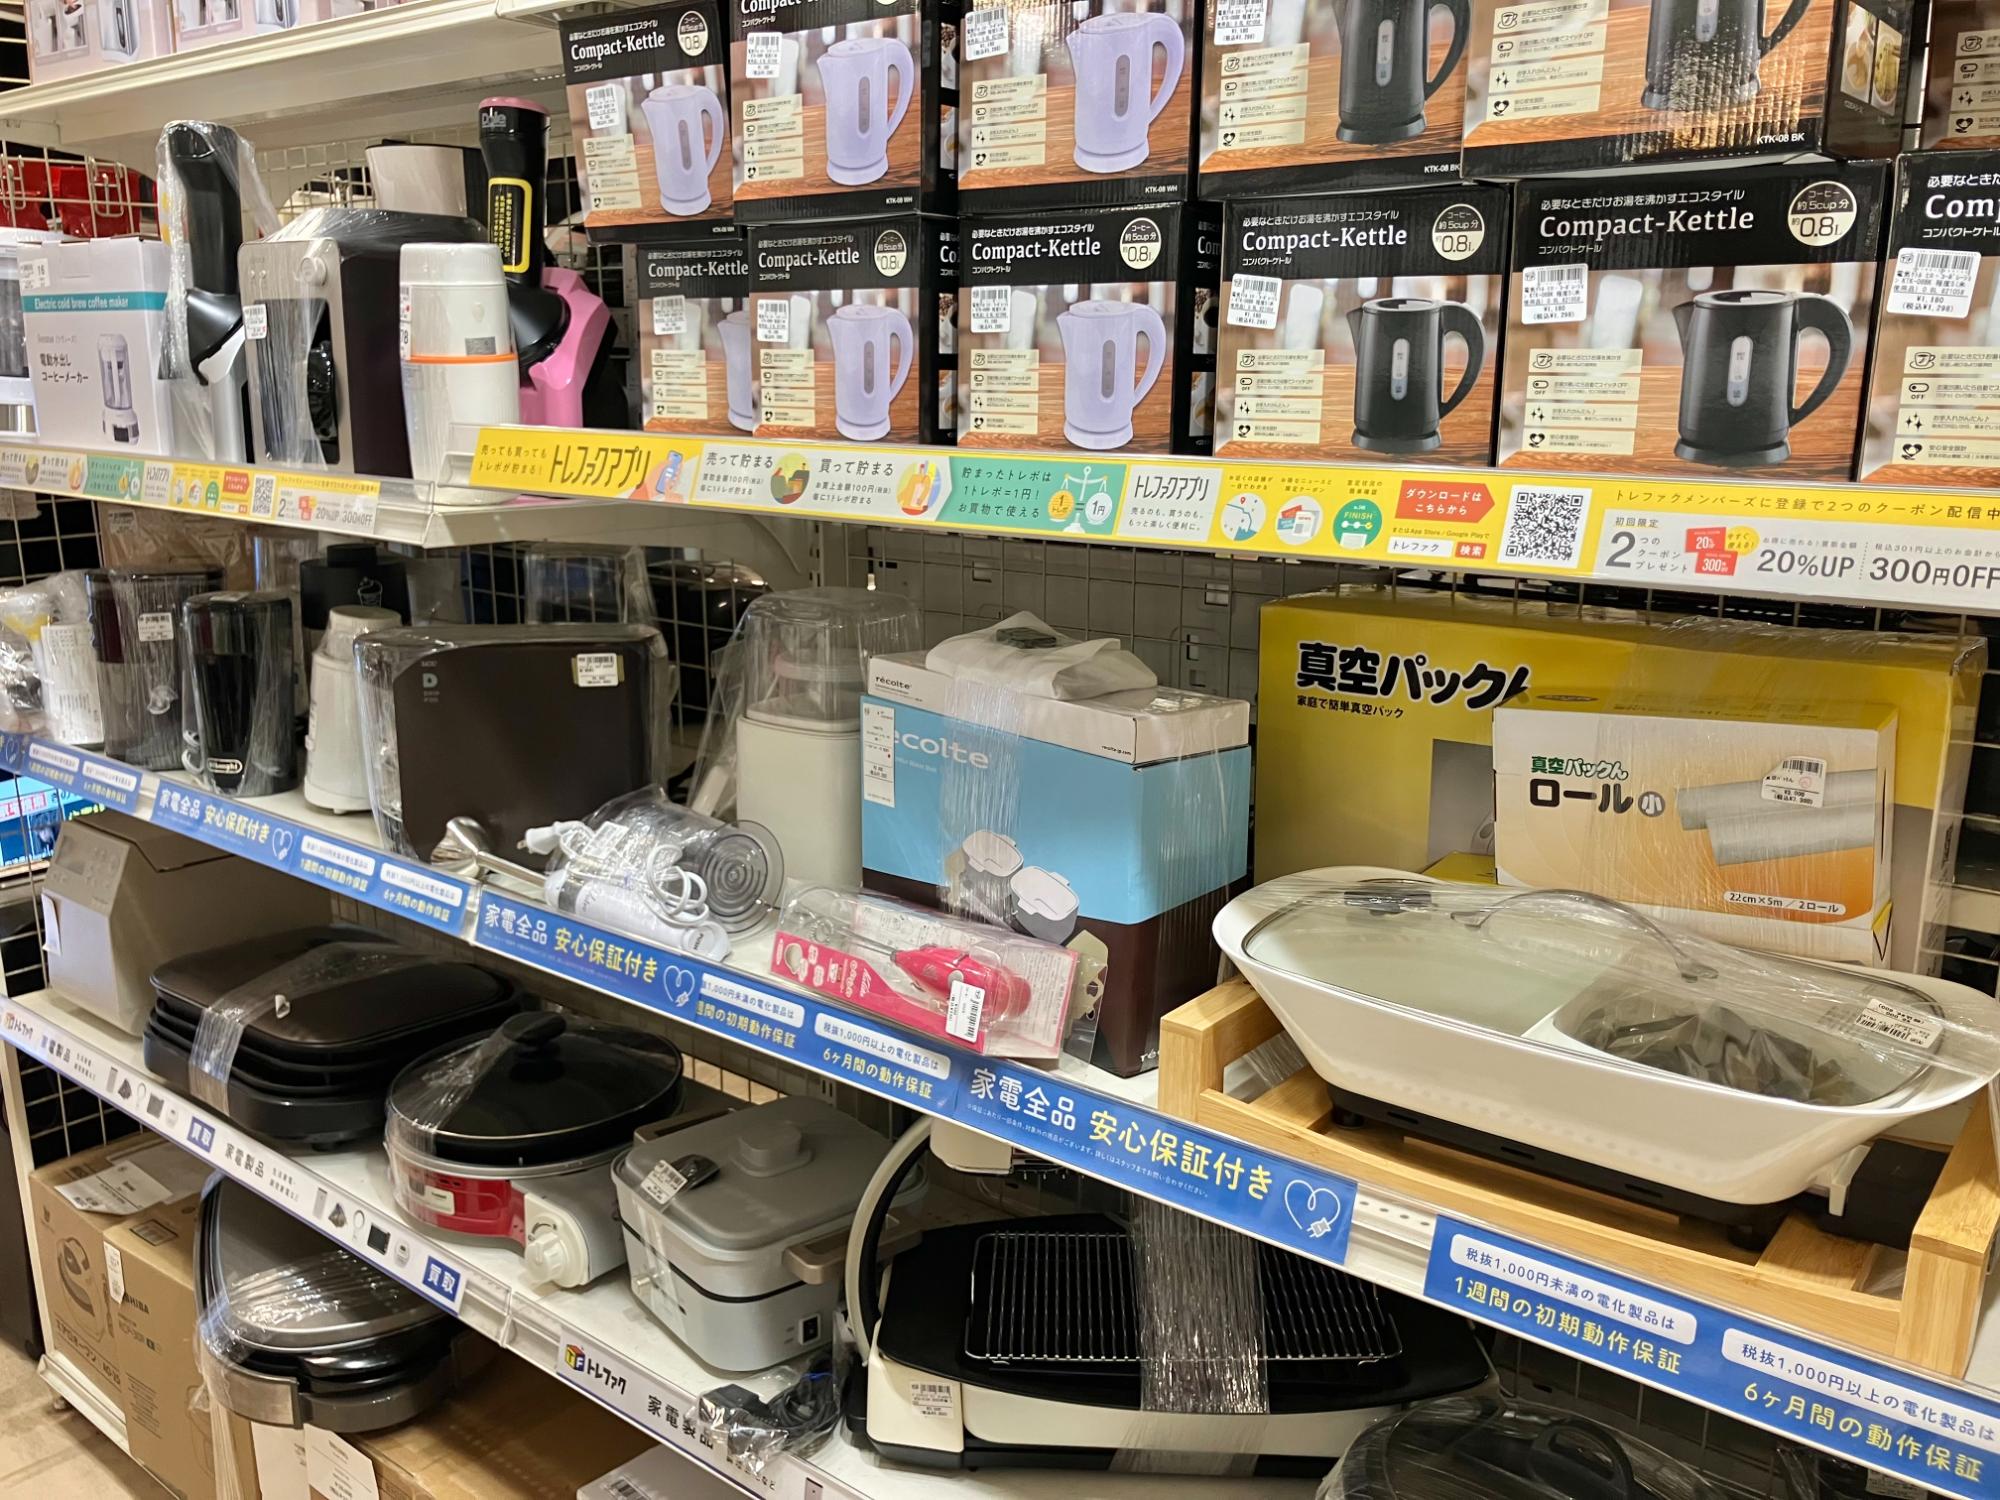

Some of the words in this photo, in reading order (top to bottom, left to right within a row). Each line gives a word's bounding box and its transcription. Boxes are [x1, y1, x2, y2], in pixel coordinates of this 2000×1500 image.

[571, 31, 666, 61] Compact-Kettle
[1757, 134, 1790, 145] KTK-08
[1791, 132, 1805, 142] BK
[1424, 166, 1448, 174] KTK-08
[1541, 190, 1745, 211] 必要なときだけお湯を沸かすエコスタイル
[1808, 190, 1841, 199] コーヒー
[1539, 206, 1755, 241] Compact-Kettle
[972, 237, 1101, 263] Compact-Kettle
[1242, 224, 1408, 257] Compact-Kettle
[1538, 243, 1603, 256] コンパクトケトル
[648, 260, 749, 281] Compact-Kettle
[758, 247, 860, 272] Compact-Kettle
[88, 296, 108, 309] coffee
[41, 372, 88, 383] コーヒーメーカー
[481, 445, 547, 459] 売っても買っても
[706, 451, 773, 469] 売って貯まる
[549, 444, 652, 491] トレファクアプリ
[818, 458, 895, 476] 買って貯まる
[962, 466, 1052, 483] 貯まったトレポは
[1134, 474, 1210, 502] トレファクアプリ
[1406, 486, 1483, 503] ダウンロードは
[959, 501, 1041, 519] お買物で使える
[1092, 500, 1106, 516] 1円
[1415, 503, 1468, 516] こちらから
[1616, 517, 1659, 529] 初回限定
[1393, 540, 1439, 552] トレファク
[1460, 544, 1482, 557] 検索
[1605, 531, 1636, 568] 2
[1639, 550, 1681, 560] クーポン
[1758, 549, 1856, 580] 20%UP
[1870, 556, 2000, 590] 300円OFF
[875, 676, 911, 690] récolte
[1297, 695, 1405, 719] 家庭で簡単真空パック
[894, 729, 990, 769] colte
[1531, 755, 1629, 781] 真空パックん
[1529, 778, 1634, 814] ロール
[160, 788, 201, 821] 家電全品
[204, 803, 270, 844] 安心保証付き
[1799, 900, 1840, 914] 2ロール
[485, 903, 548, 946] 家電全品
[553, 926, 659, 984] 安心保証付き
[823, 1021, 939, 1072] 税抜1,000円以上の電化製品は
[968, 1066, 1078, 1132] 家電全品
[1088, 1109, 1274, 1202] 安心保証付き
[224, 1142, 265, 1178] 家電製品
[427, 1263, 457, 1296] 買取
[1464, 1245, 1677, 1333] 税抜1,000円未満の電化製品は
[1453, 1274, 1685, 1377] 1週間の初期動作保証
[588, 1358, 627, 1395] トレファク
[1741, 1342, 1996, 1442] 税抜1,000円以上の電化製品は
[1743, 1381, 1984, 1484] 6ヶ月間の動作保証
